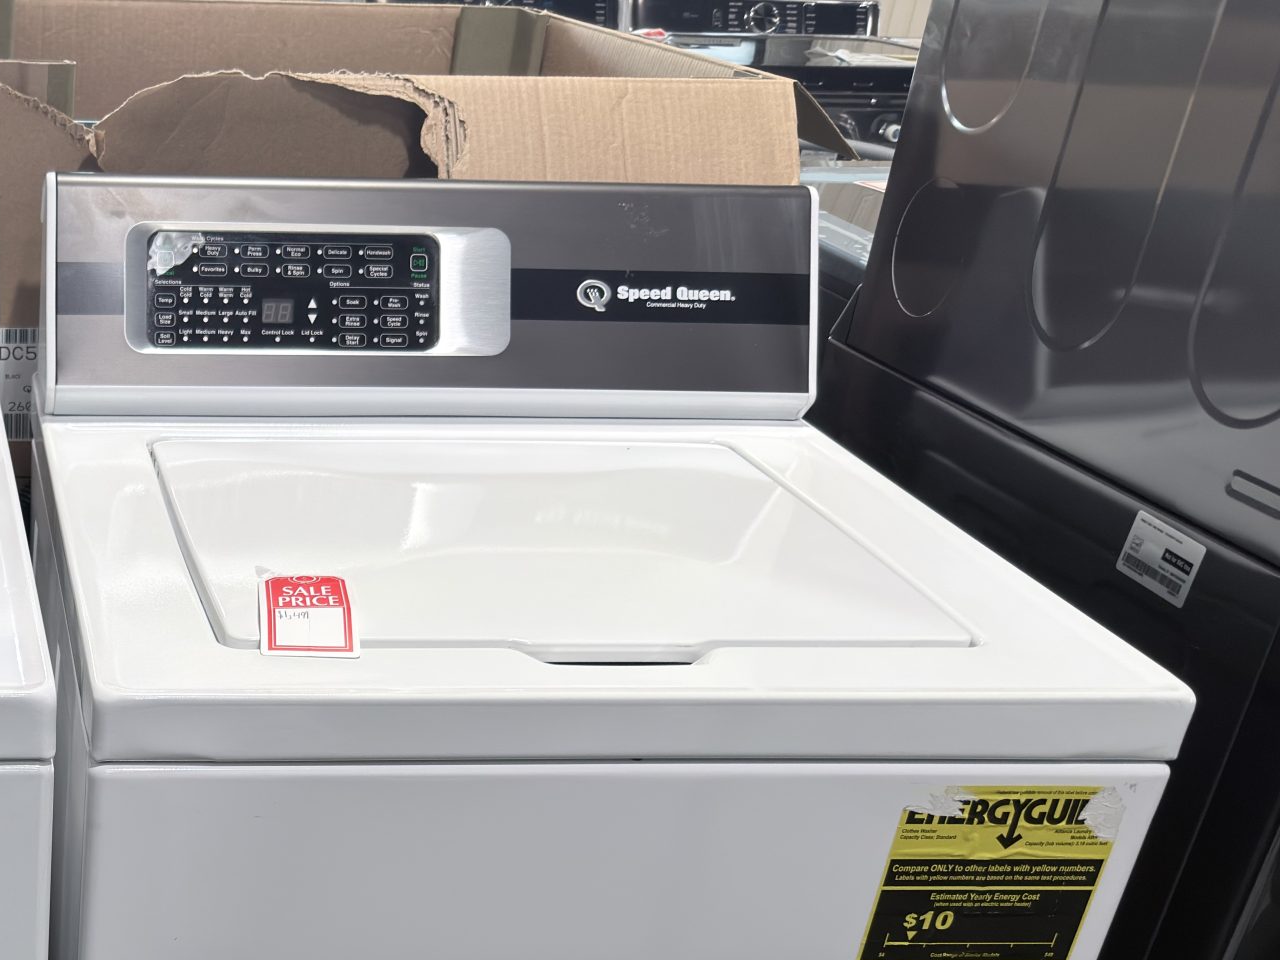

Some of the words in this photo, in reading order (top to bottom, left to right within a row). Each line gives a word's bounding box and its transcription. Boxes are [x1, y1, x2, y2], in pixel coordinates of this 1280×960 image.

[617, 285, 672, 302] Speed
[282, 585, 332, 596] SALE
[278, 596, 339, 607] PRICE
[892, 864, 929, 873] Compare
[930, 864, 954, 872] ONLY
[965, 864, 987, 872] other
[988, 864, 1011, 872] labels
[1013, 864, 1030, 872] with
[1031, 864, 1058, 874] yellow
[1059, 864, 1096, 872] numbers.
[970, 893, 992, 901] Yearly
[994, 893, 1021, 901] Energy
[903, 910, 955, 930] $10
